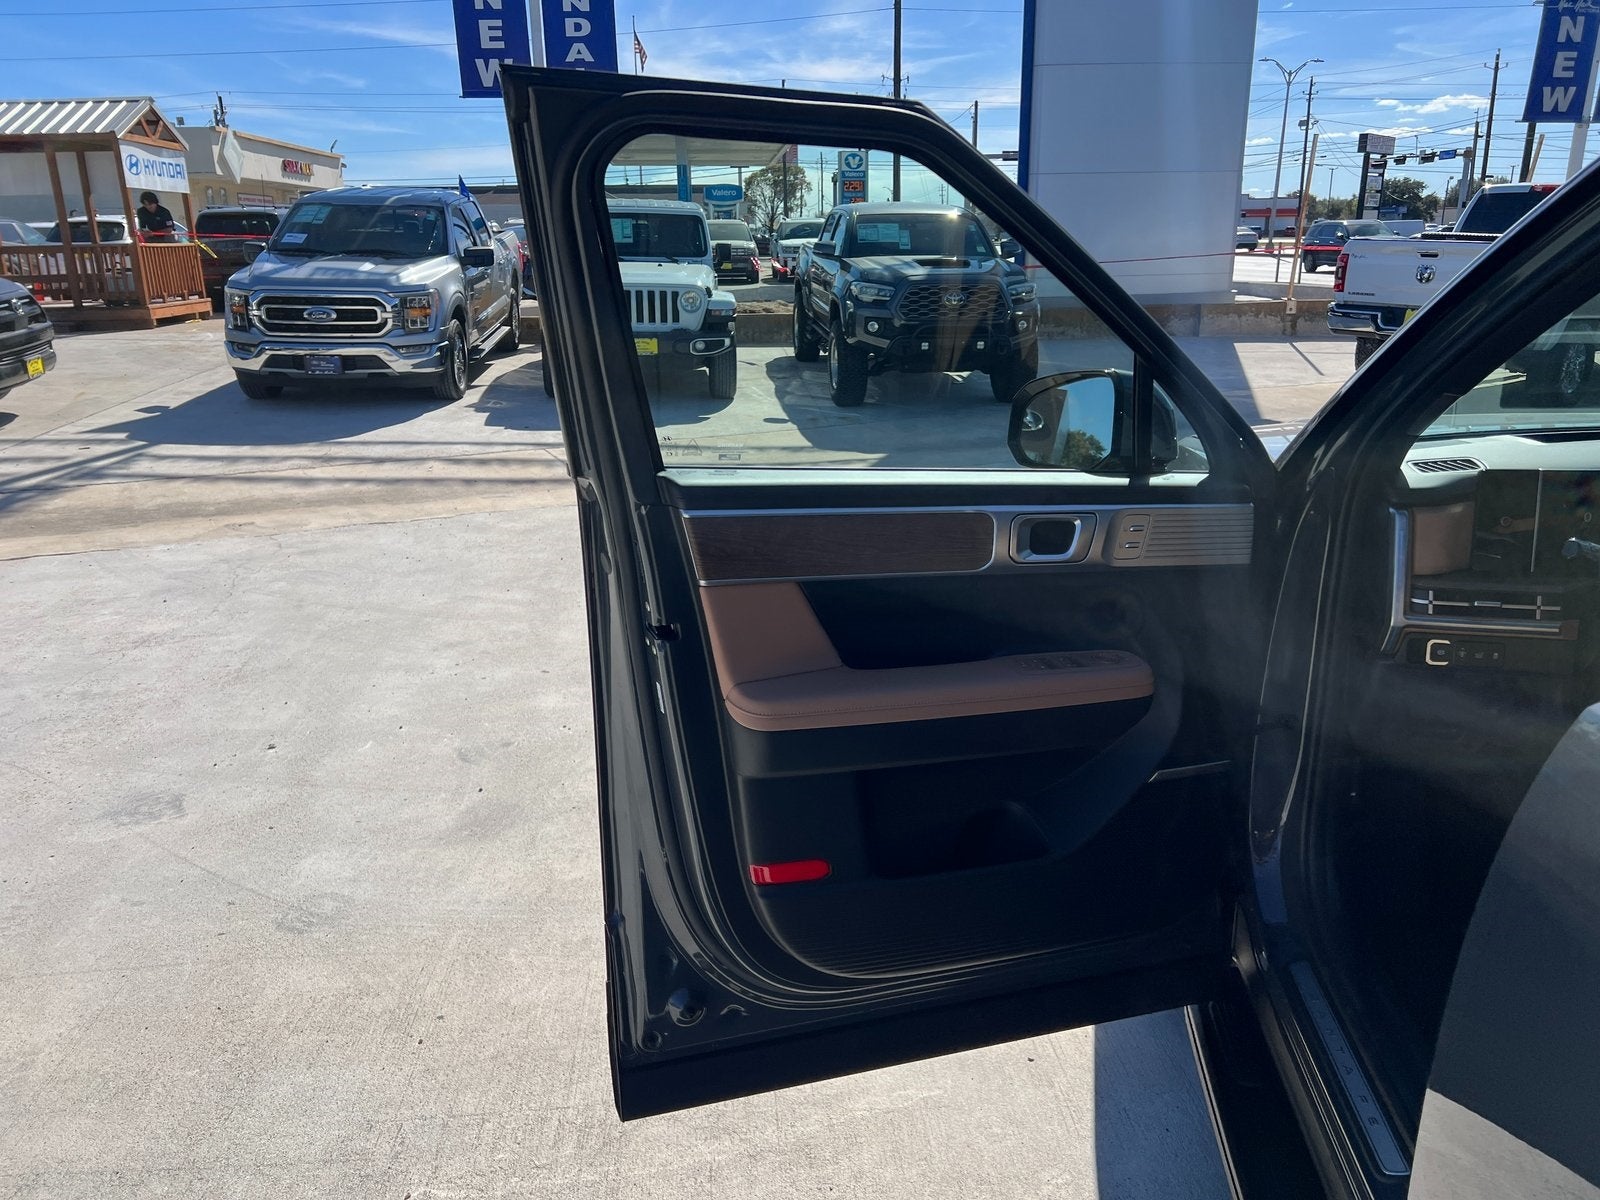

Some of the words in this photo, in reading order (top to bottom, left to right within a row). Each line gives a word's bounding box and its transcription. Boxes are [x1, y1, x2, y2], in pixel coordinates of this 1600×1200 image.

[1542, 16, 1585, 113] NEW
[143, 158, 186, 180] HYUNDAI
[311, 311, 328, 319] Ford
